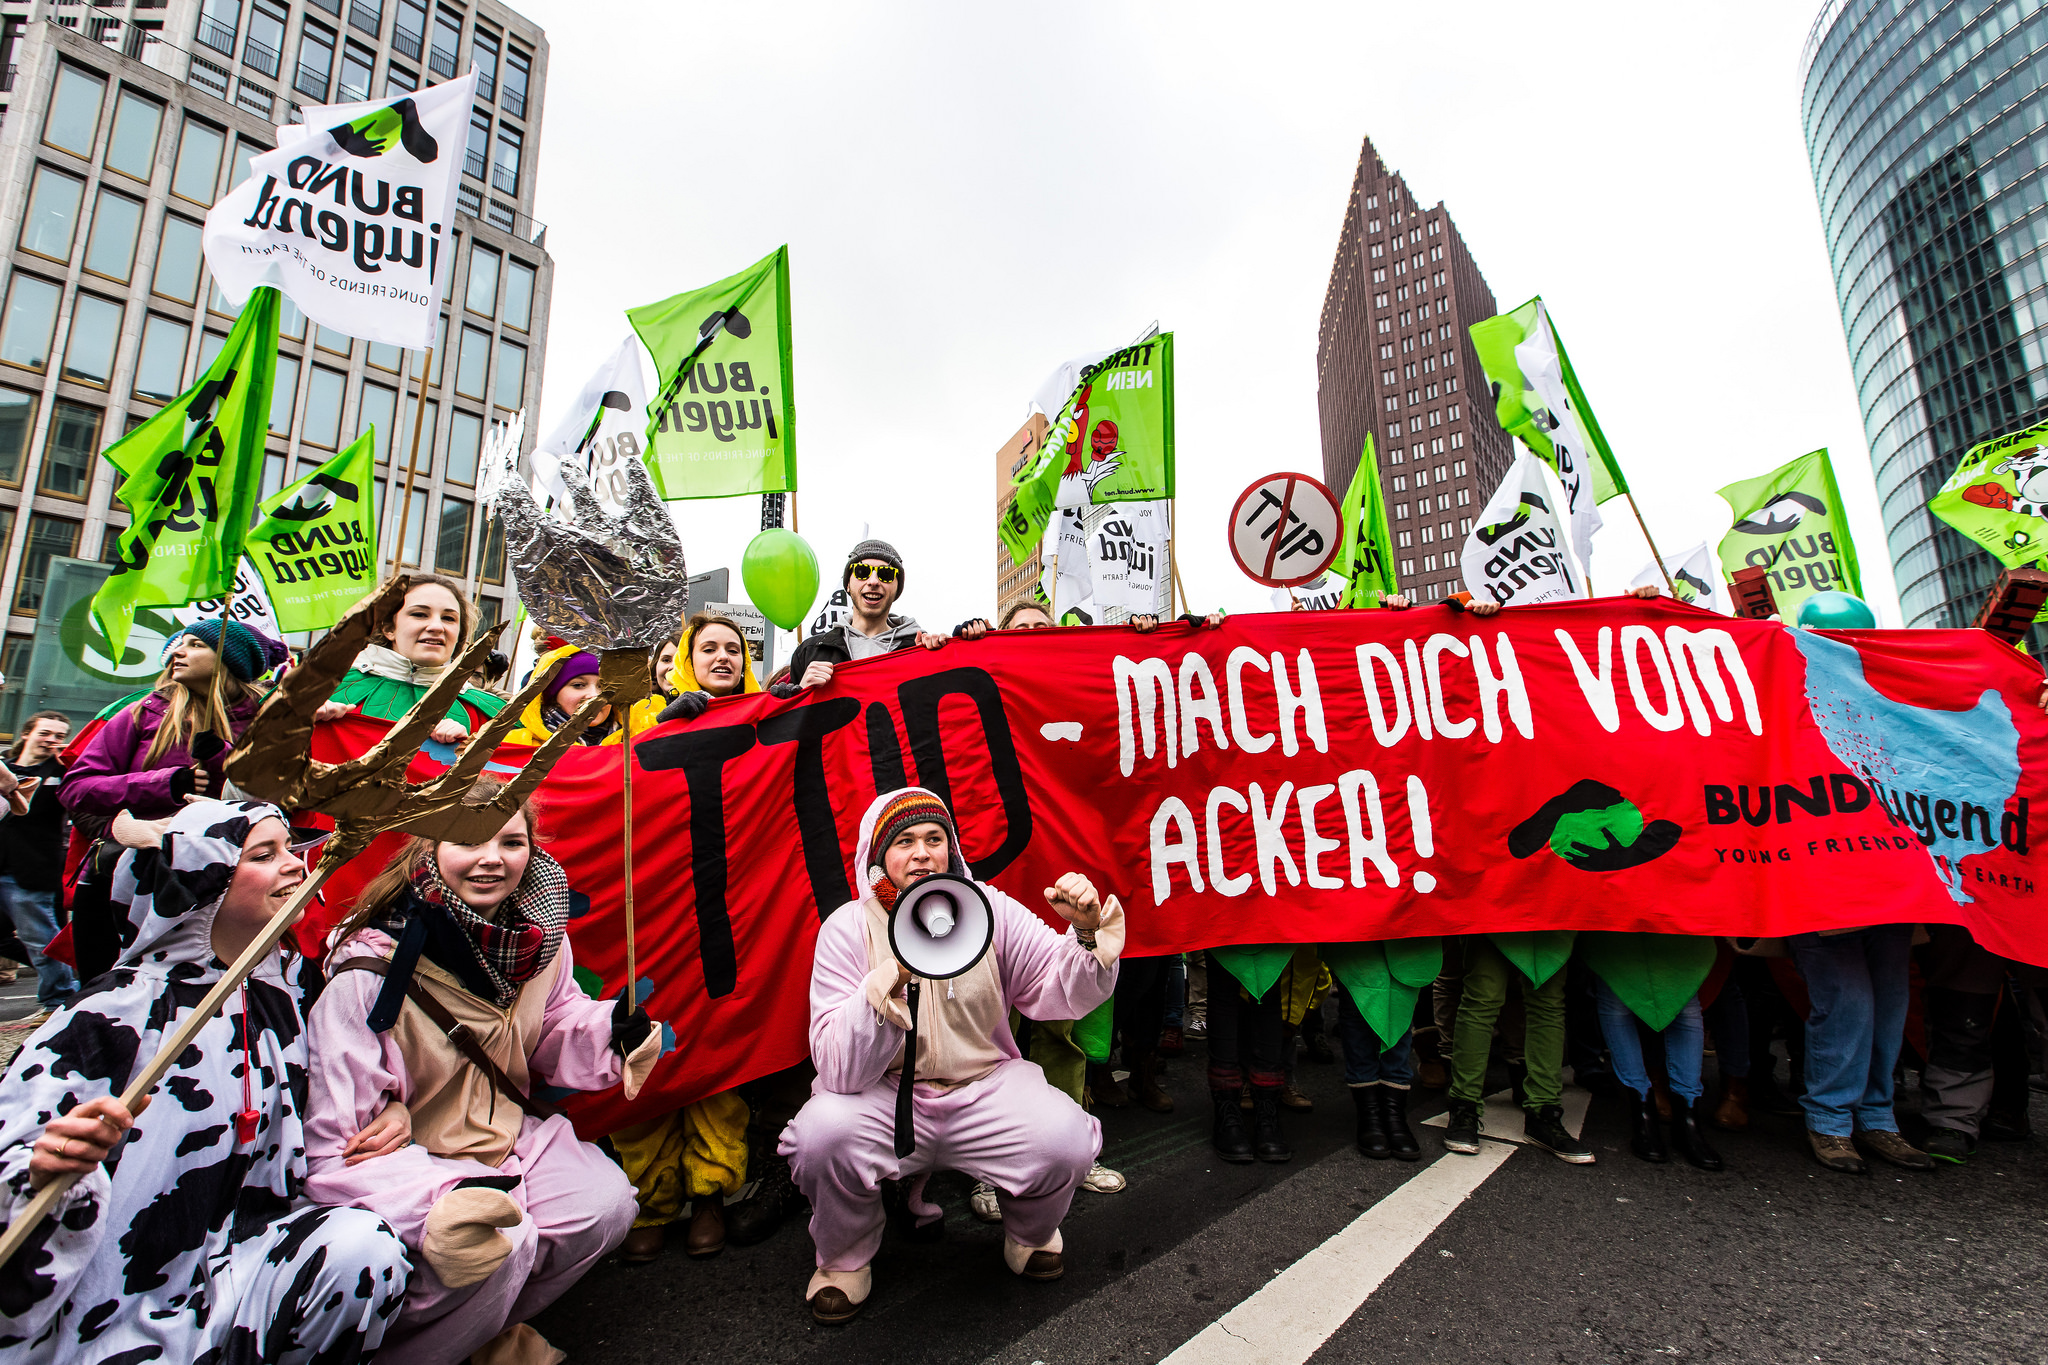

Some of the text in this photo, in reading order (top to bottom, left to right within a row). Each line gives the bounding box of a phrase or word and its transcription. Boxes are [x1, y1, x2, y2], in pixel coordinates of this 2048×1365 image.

[1245, 488, 1324, 561] TTIP
[1111, 646, 1329, 778] MACH
[1355, 631, 1535, 748] DICH
[1554, 624, 1763, 738] VOM
[1149, 769, 1438, 907] ACKER!
[1714, 847, 1792, 864] YOUNG
[1975, 867, 2035, 893] EARTH
